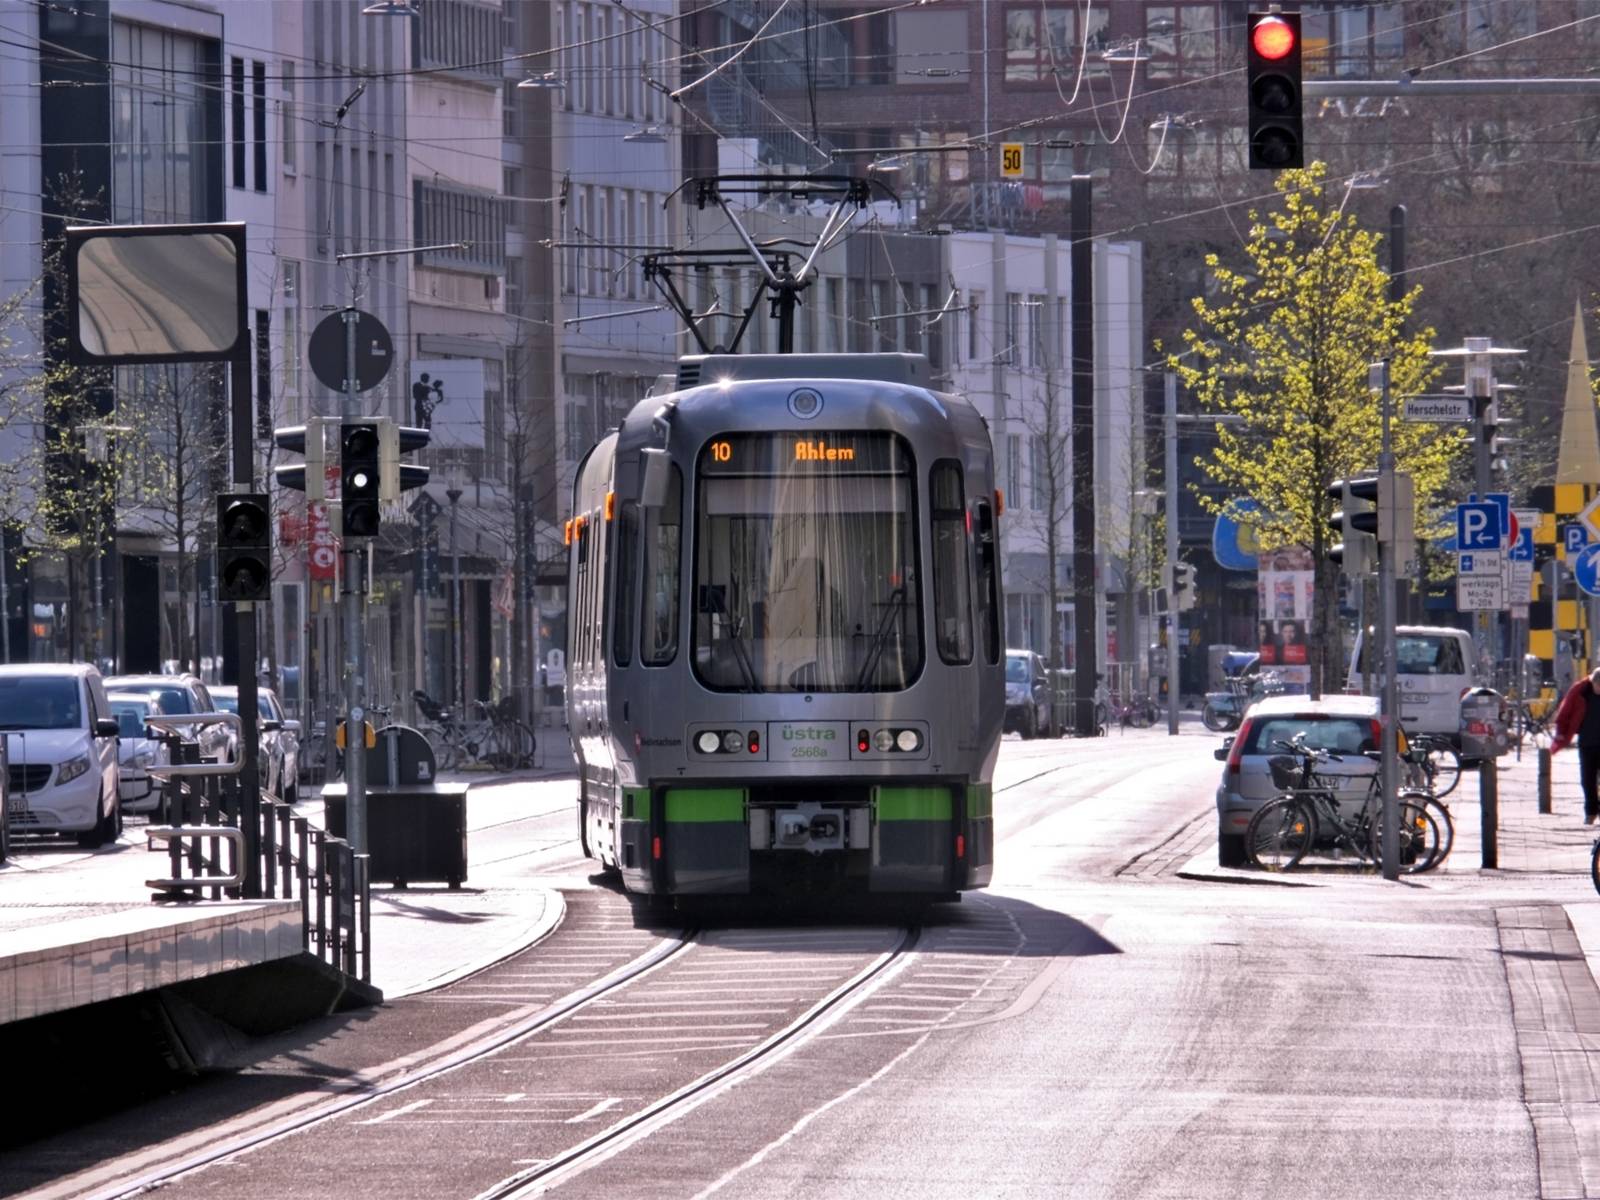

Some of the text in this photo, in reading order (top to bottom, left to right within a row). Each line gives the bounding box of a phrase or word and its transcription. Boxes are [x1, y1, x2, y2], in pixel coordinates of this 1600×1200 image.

[1003, 149, 1021, 170] 50
[1407, 404, 1463, 415] Herschelstr.
[711, 442, 731, 461] 10
[795, 442, 854, 460] Ahlem
[1464, 509, 1487, 545] P
[1568, 529, 1582, 550] P
[782, 724, 836, 741] üstra
